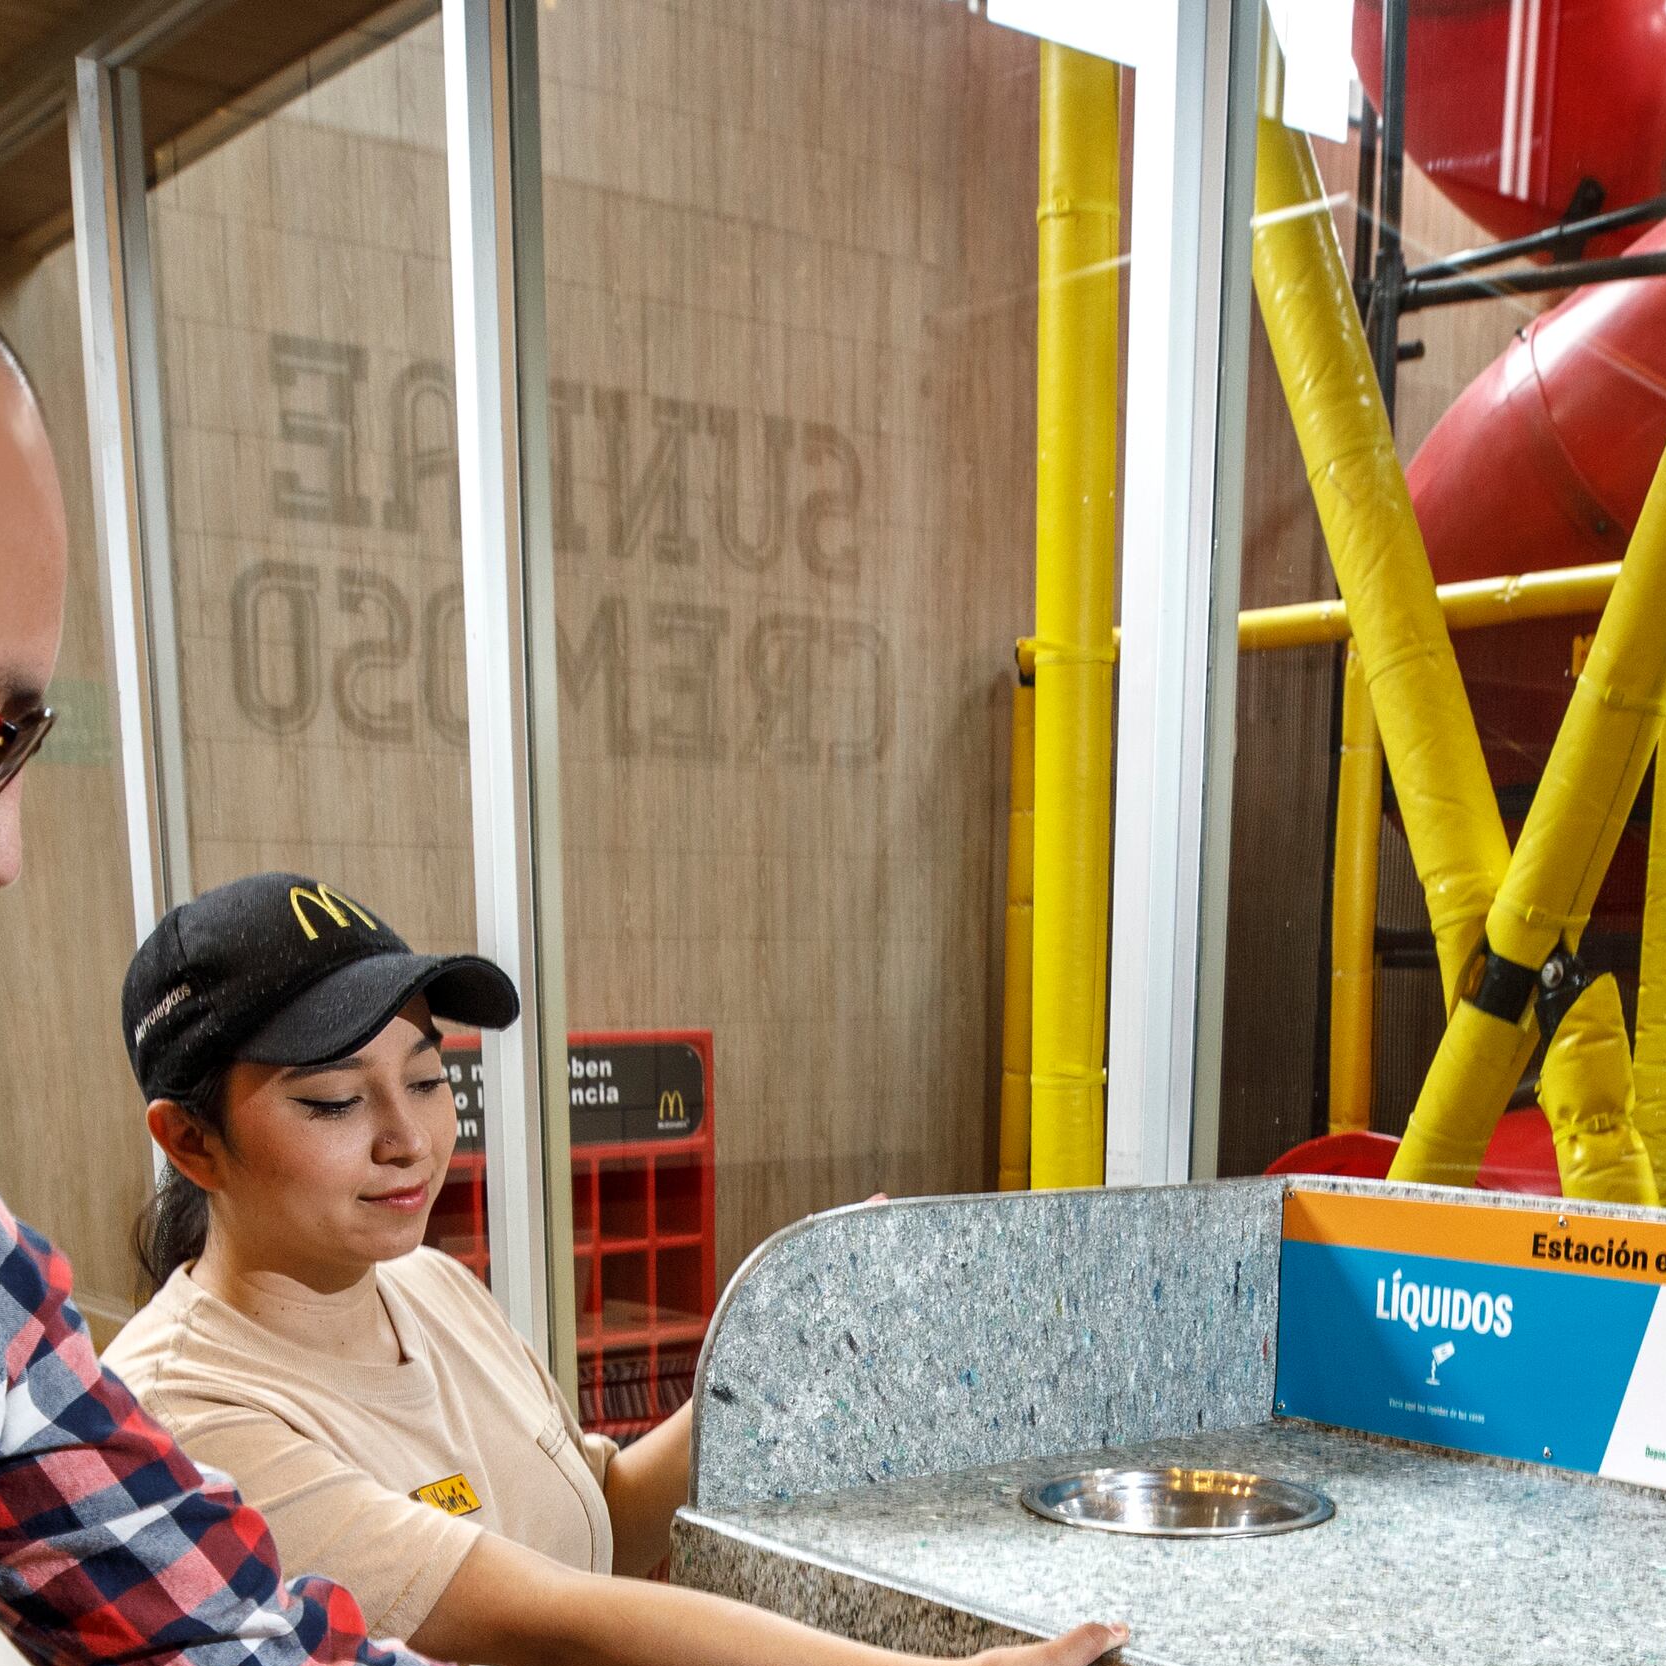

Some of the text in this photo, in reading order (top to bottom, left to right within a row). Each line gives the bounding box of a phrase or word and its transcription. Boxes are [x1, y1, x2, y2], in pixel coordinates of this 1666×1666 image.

[568, 1055, 613, 1079] ben
[568, 1081, 620, 1106] ncia
[1532, 1232, 1649, 1272] Estación
[1375, 1267, 1514, 1339] LÍQUIDOS
